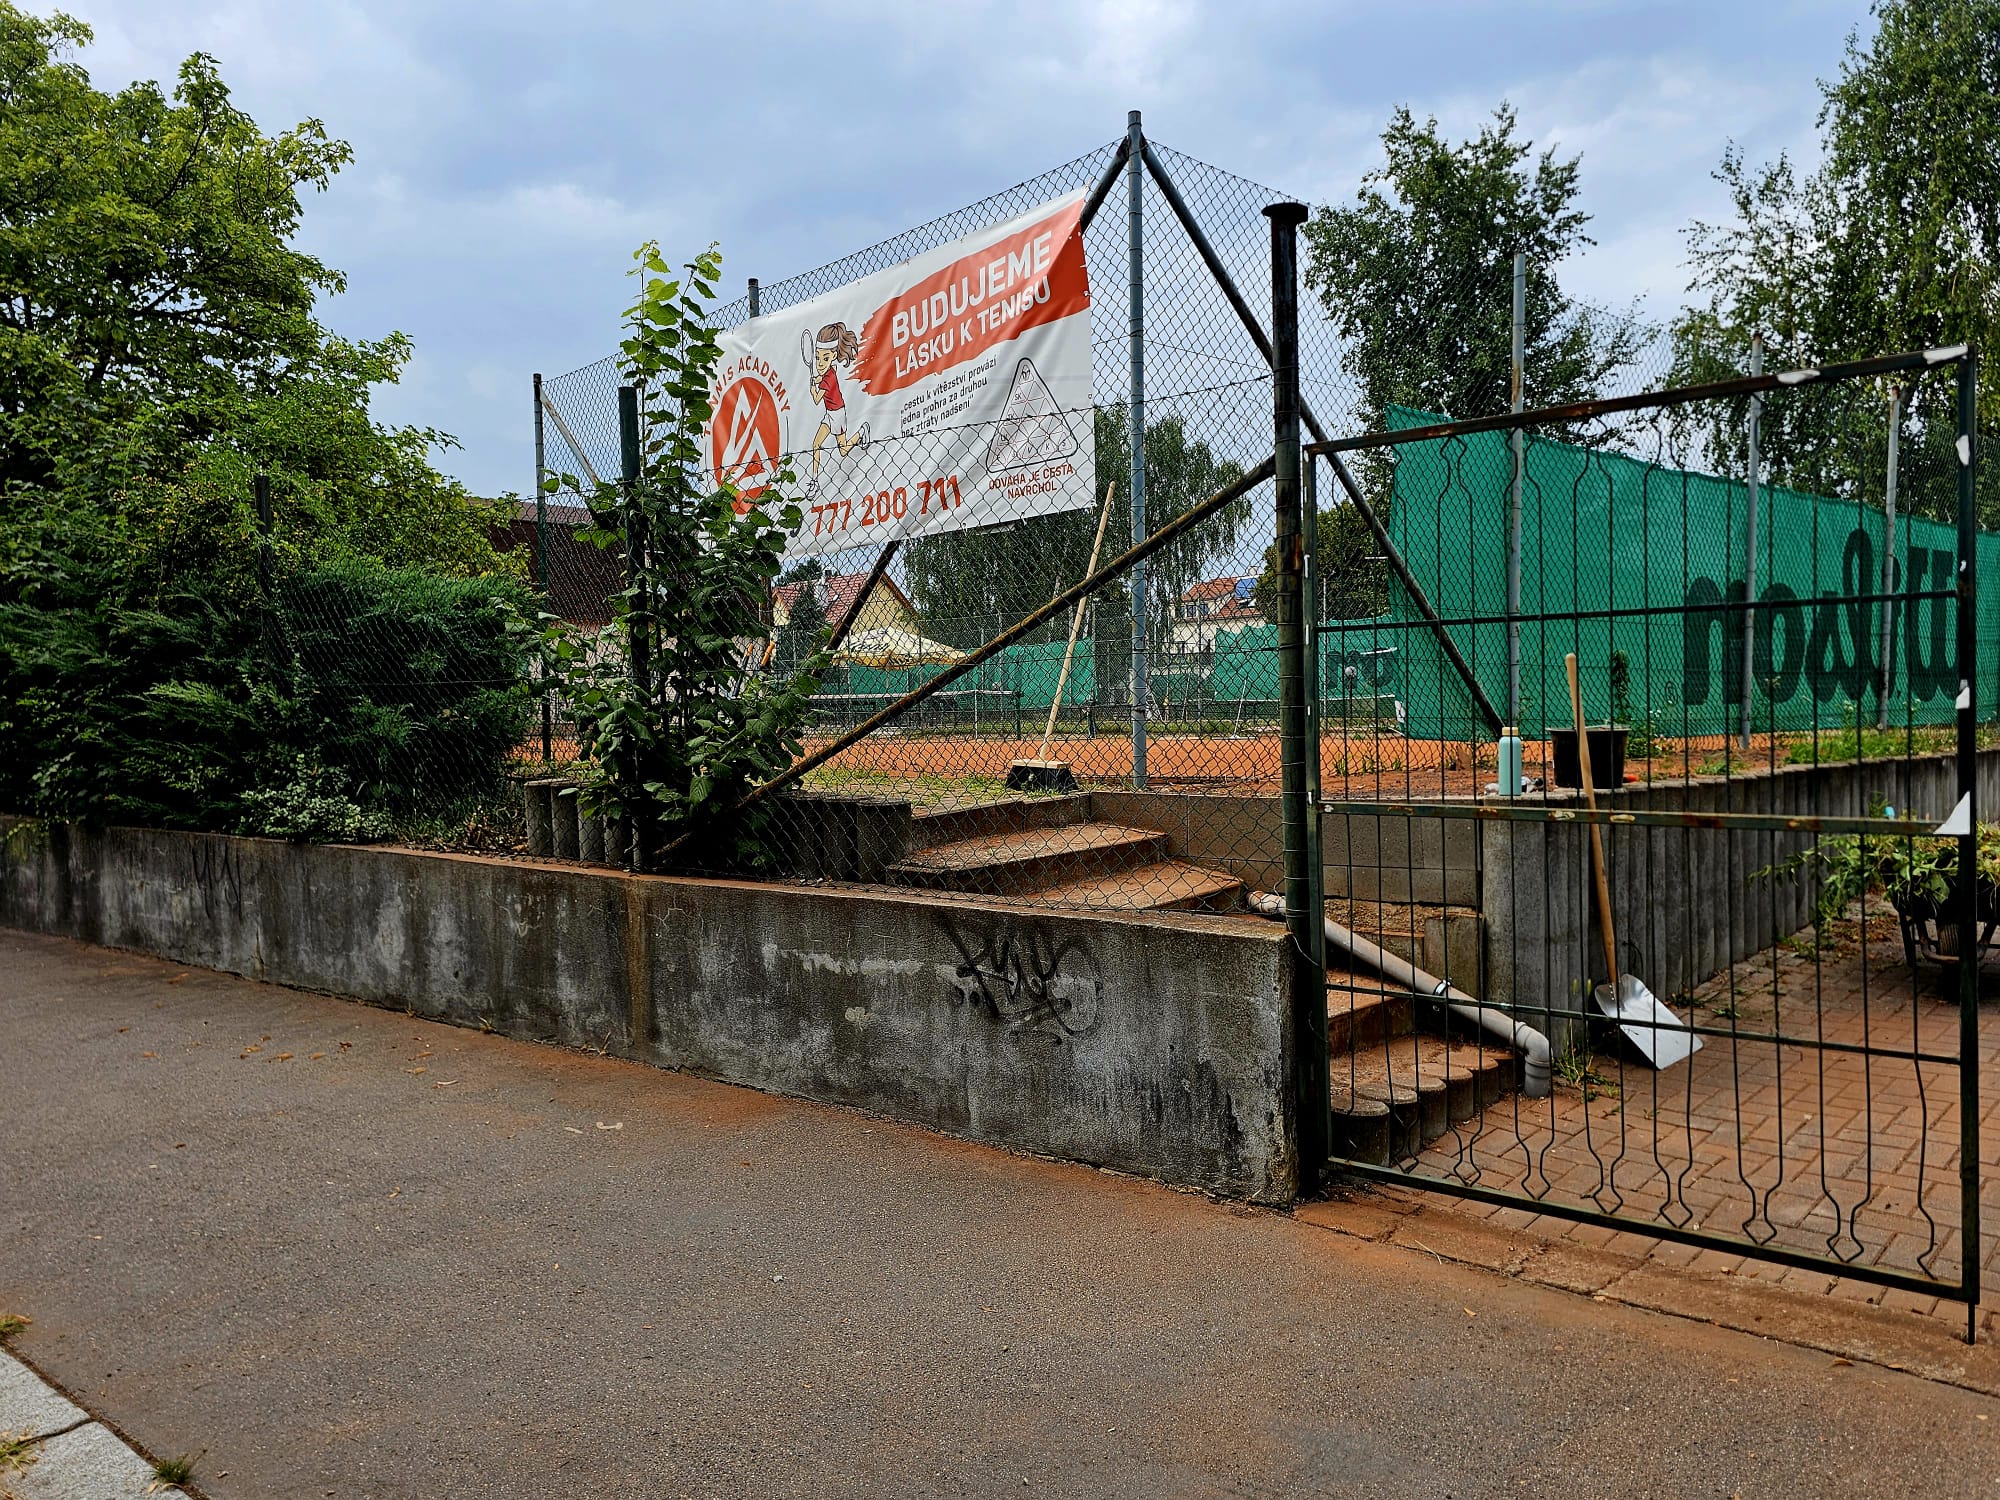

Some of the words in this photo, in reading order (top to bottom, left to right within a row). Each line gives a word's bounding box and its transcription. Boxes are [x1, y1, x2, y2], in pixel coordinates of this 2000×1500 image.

[892, 231, 1052, 349] BUDUJEME
[895, 327, 955, 379] LÁSKU
[960, 318, 973, 346] K
[976, 275, 1051, 336] TENISU
[703, 365, 734, 437] TNNIS
[738, 355, 791, 413] ACADEMY
[900, 411, 921, 429] jedna
[922, 399, 947, 417] prohra
[949, 391, 958, 403] za
[960, 376, 988, 397] druhou
[926, 389, 932, 399] k
[933, 370, 966, 397] vítězství
[968, 354, 997, 381] provází
[916, 413, 939, 433] ztráty
[988, 473, 1027, 490] ODVAHA
[1028, 470, 1041, 484] JE
[1042, 463, 1074, 480] CESTA
[1007, 480, 1058, 500] NAVRCHOL
[811, 499, 852, 537] 777
[860, 486, 908, 527] 200
[916, 474, 961, 515] 711
